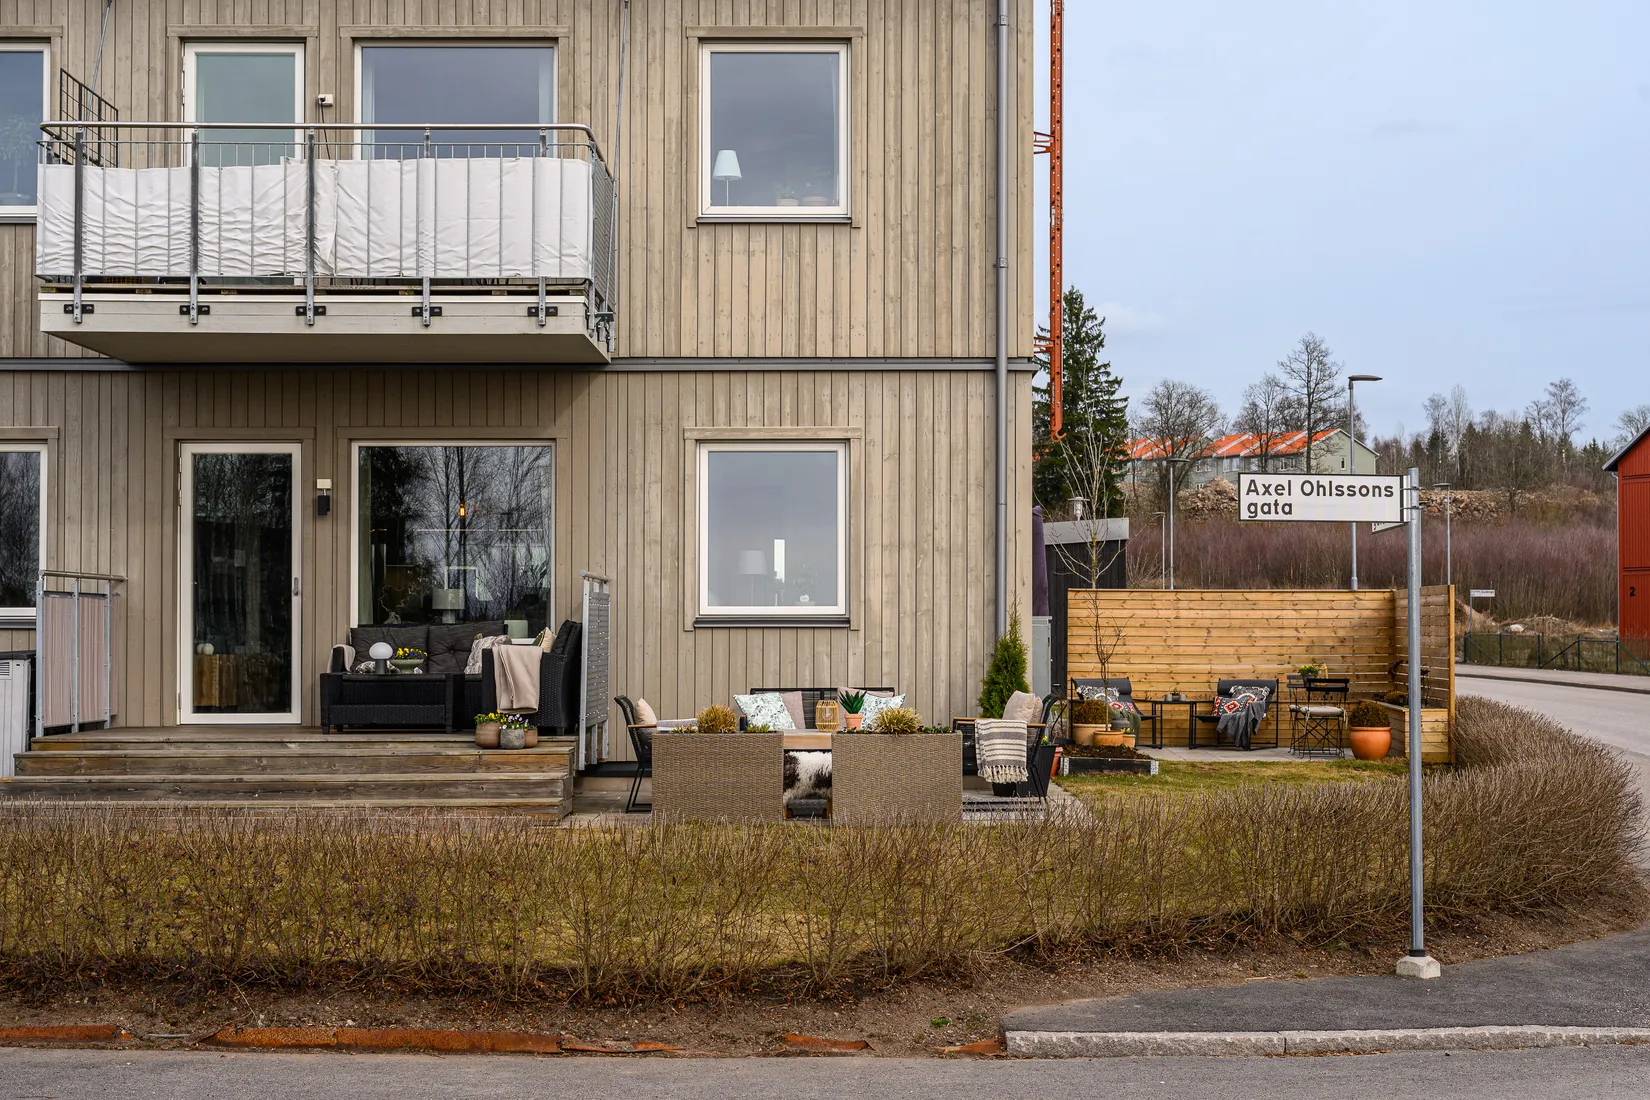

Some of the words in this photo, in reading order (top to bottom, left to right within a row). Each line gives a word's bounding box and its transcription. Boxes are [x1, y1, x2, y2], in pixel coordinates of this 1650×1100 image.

[1245, 479, 1292, 496] Axel
[1300, 480, 1394, 497] Ohlssons
[1247, 499, 1293, 519] gata
[1629, 586, 1636, 597] 2
